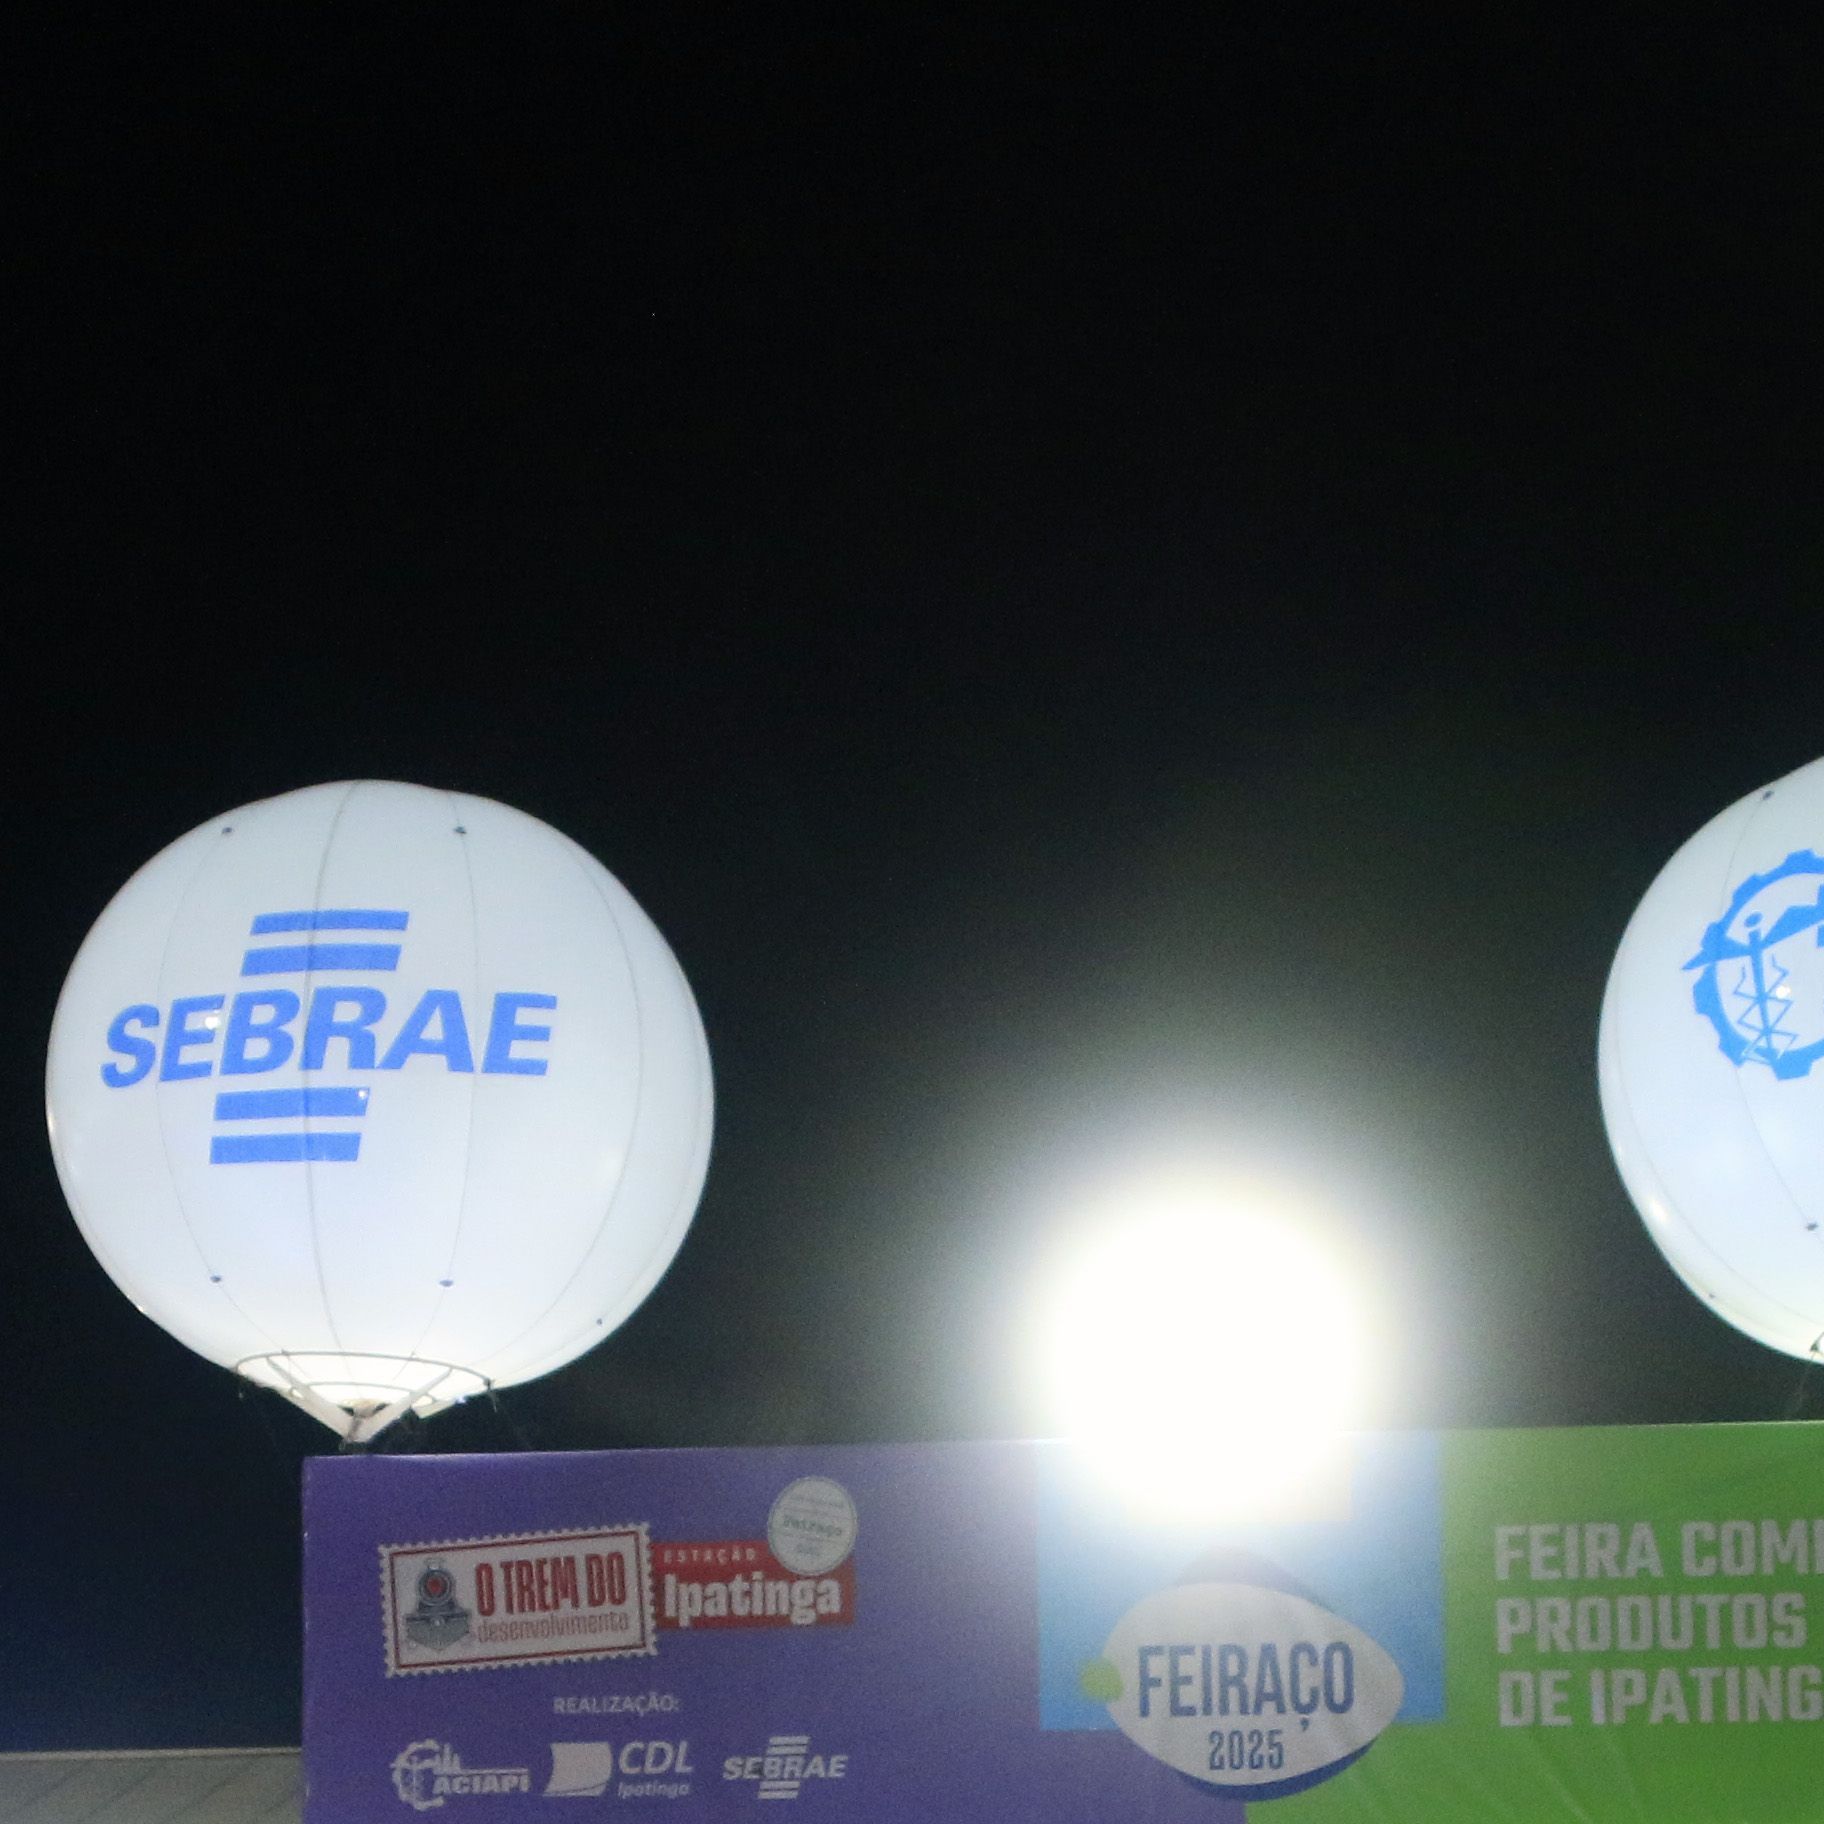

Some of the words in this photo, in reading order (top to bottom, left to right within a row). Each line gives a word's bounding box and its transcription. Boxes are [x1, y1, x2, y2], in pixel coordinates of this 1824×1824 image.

[100, 986, 558, 1088] SEBRAE
[662, 1546, 758, 1566] ESTAÇÃO
[1494, 1522, 1664, 1581] FEIRA
[475, 1561, 495, 1614] O
[499, 1555, 578, 1611] TREM
[587, 1550, 628, 1606] DO
[664, 1571, 844, 1626] Ipatinga
[476, 1610, 631, 1645] desenvolvimento
[1496, 1593, 1808, 1655] PRODUTOS
[553, 1692, 679, 1719] REALIZAÇÃO:
[1137, 1641, 1355, 1733] FEIRAÇO
[1499, 1669, 1574, 1729] DE
[618, 1740, 693, 1774] CDL
[722, 1754, 848, 1780] SEBRAE
[1207, 1729, 1285, 1771] 2025
[433, 1772, 531, 1795] ACIAPI
[617, 1779, 690, 1800] Ipatinga
